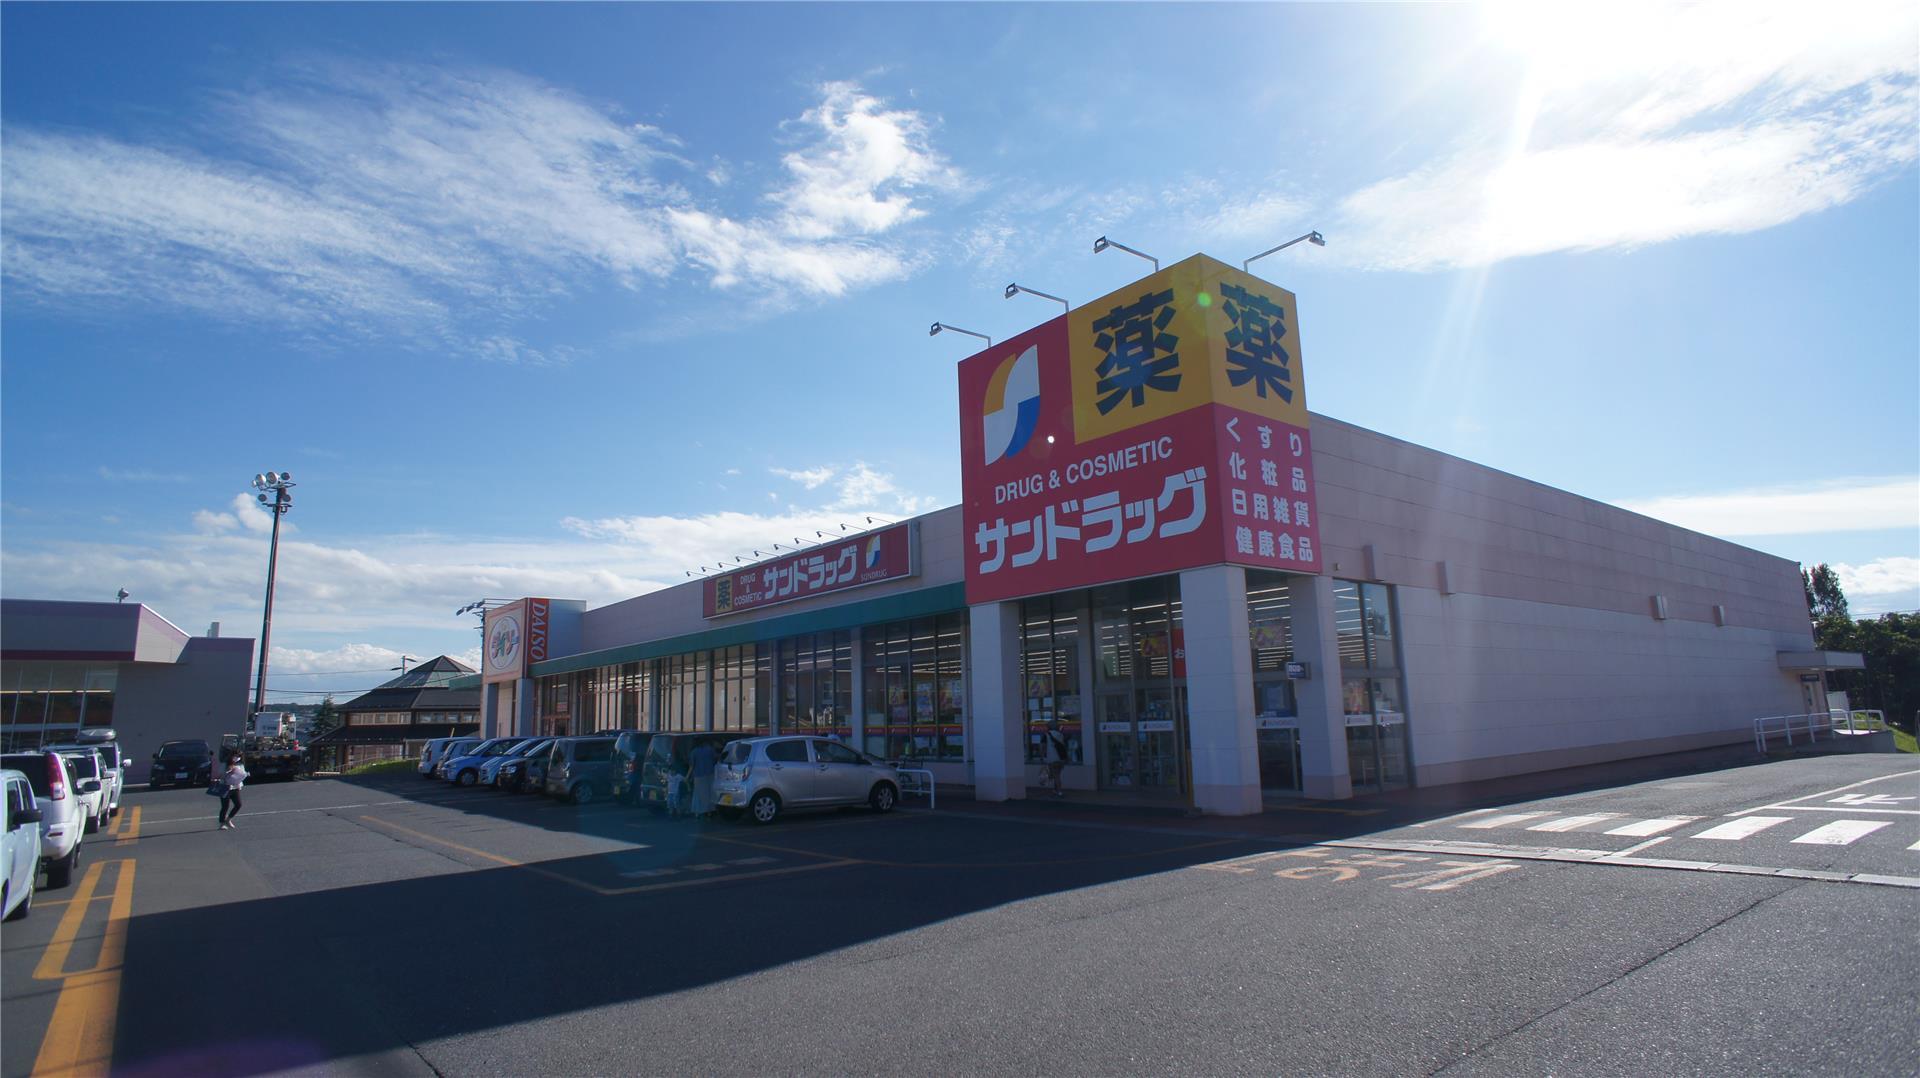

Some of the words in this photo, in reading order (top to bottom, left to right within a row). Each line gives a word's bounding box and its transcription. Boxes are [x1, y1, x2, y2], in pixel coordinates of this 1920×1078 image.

[1092, 288, 1183, 416] 薬
[1220, 281, 1293, 405] 薬
[1226, 417, 1302, 457] くすり
[995, 474, 1044, 504] DRUG
[1049, 472, 1060, 489] &
[1066, 436, 1173, 484] COSMETIC
[1229, 452, 1307, 493] 化粧品
[975, 466, 1207, 575] サンドラッグ
[1232, 488, 1310, 528] 日用雑貨
[1236, 525, 1314, 562] 健康食品
[740, 573, 756, 584] DRUG
[763, 544, 857, 600] サンドラッグ
[717, 580, 731, 609] 薬
[734, 592, 762, 606] COSMETIC
[530, 602, 546, 660] DAISO
